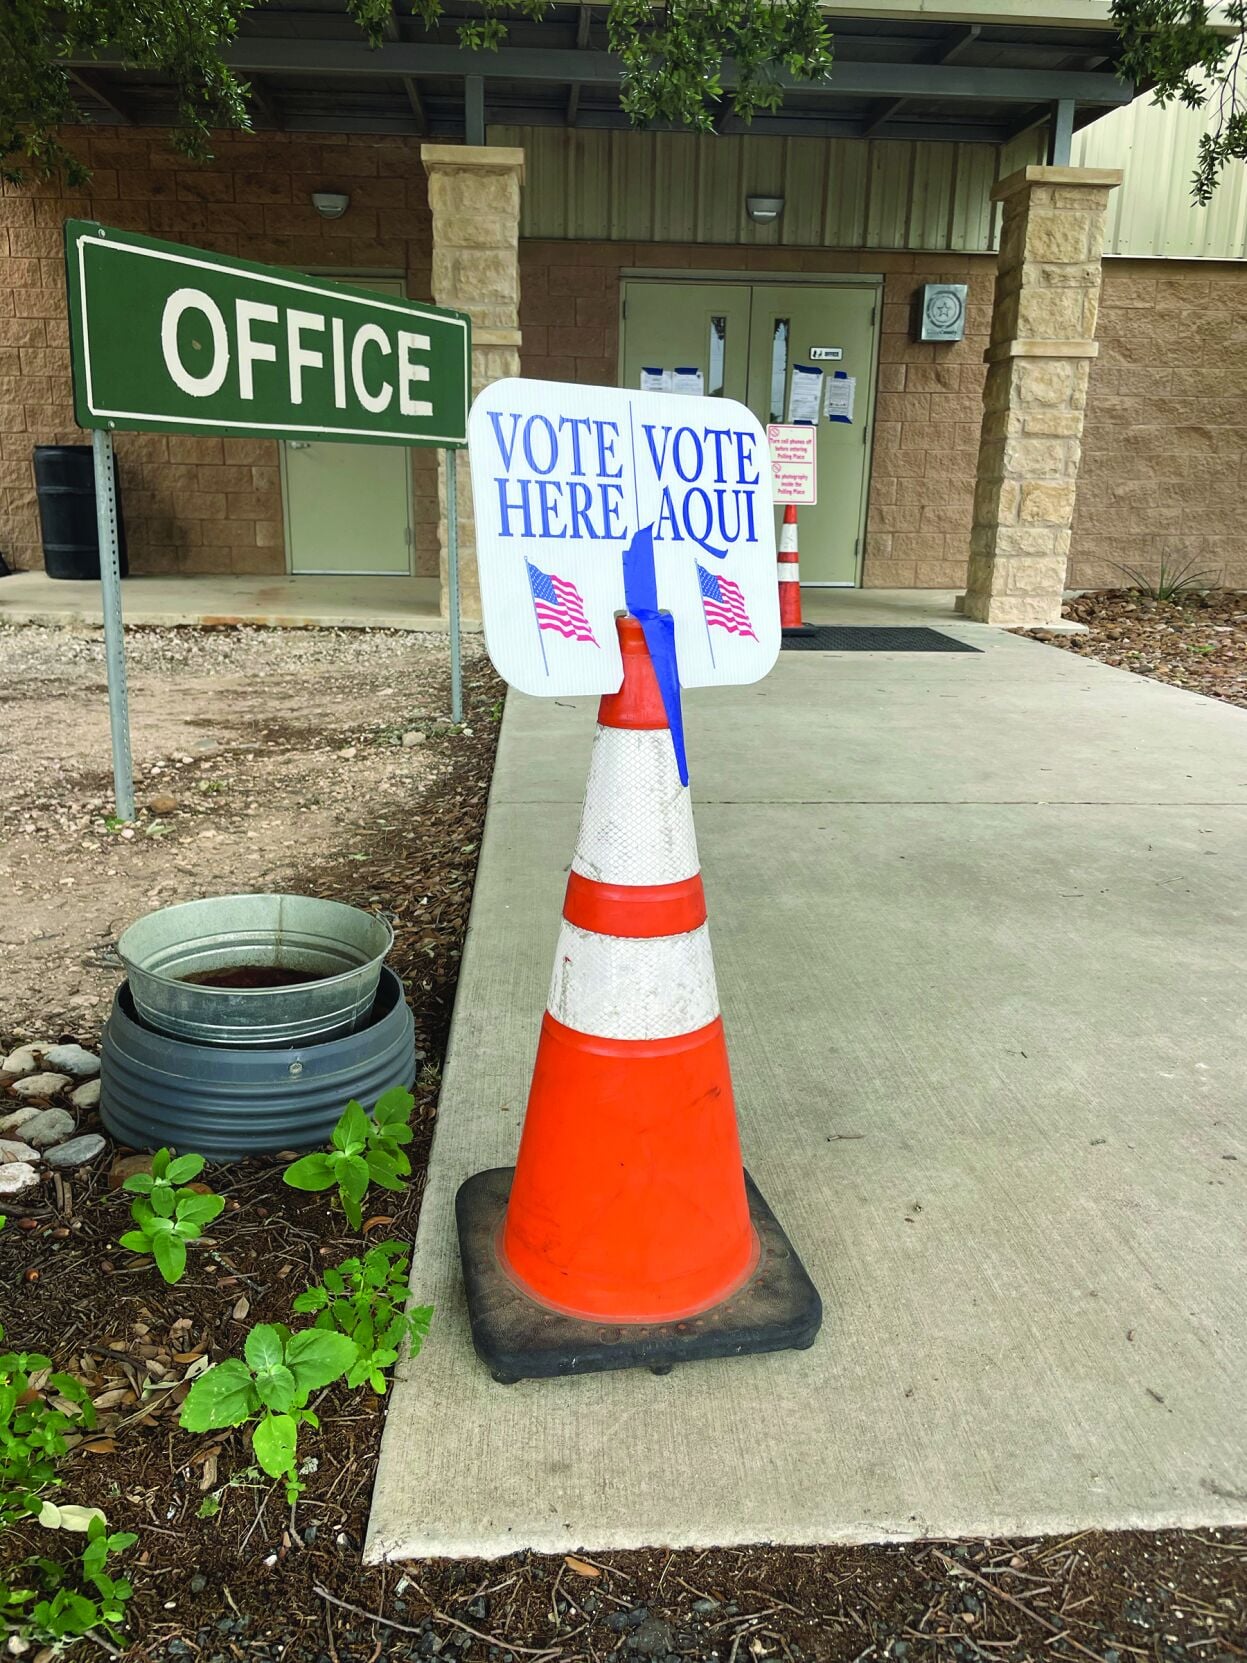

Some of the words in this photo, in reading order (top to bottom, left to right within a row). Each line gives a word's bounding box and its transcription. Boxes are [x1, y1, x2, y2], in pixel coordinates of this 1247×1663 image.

[161, 287, 434, 417] OFFICE
[486, 411, 624, 478] VOTE
[641, 424, 760, 486] VOTE
[493, 477, 628, 540] HERE
[653, 485, 759, 559] AQUI
